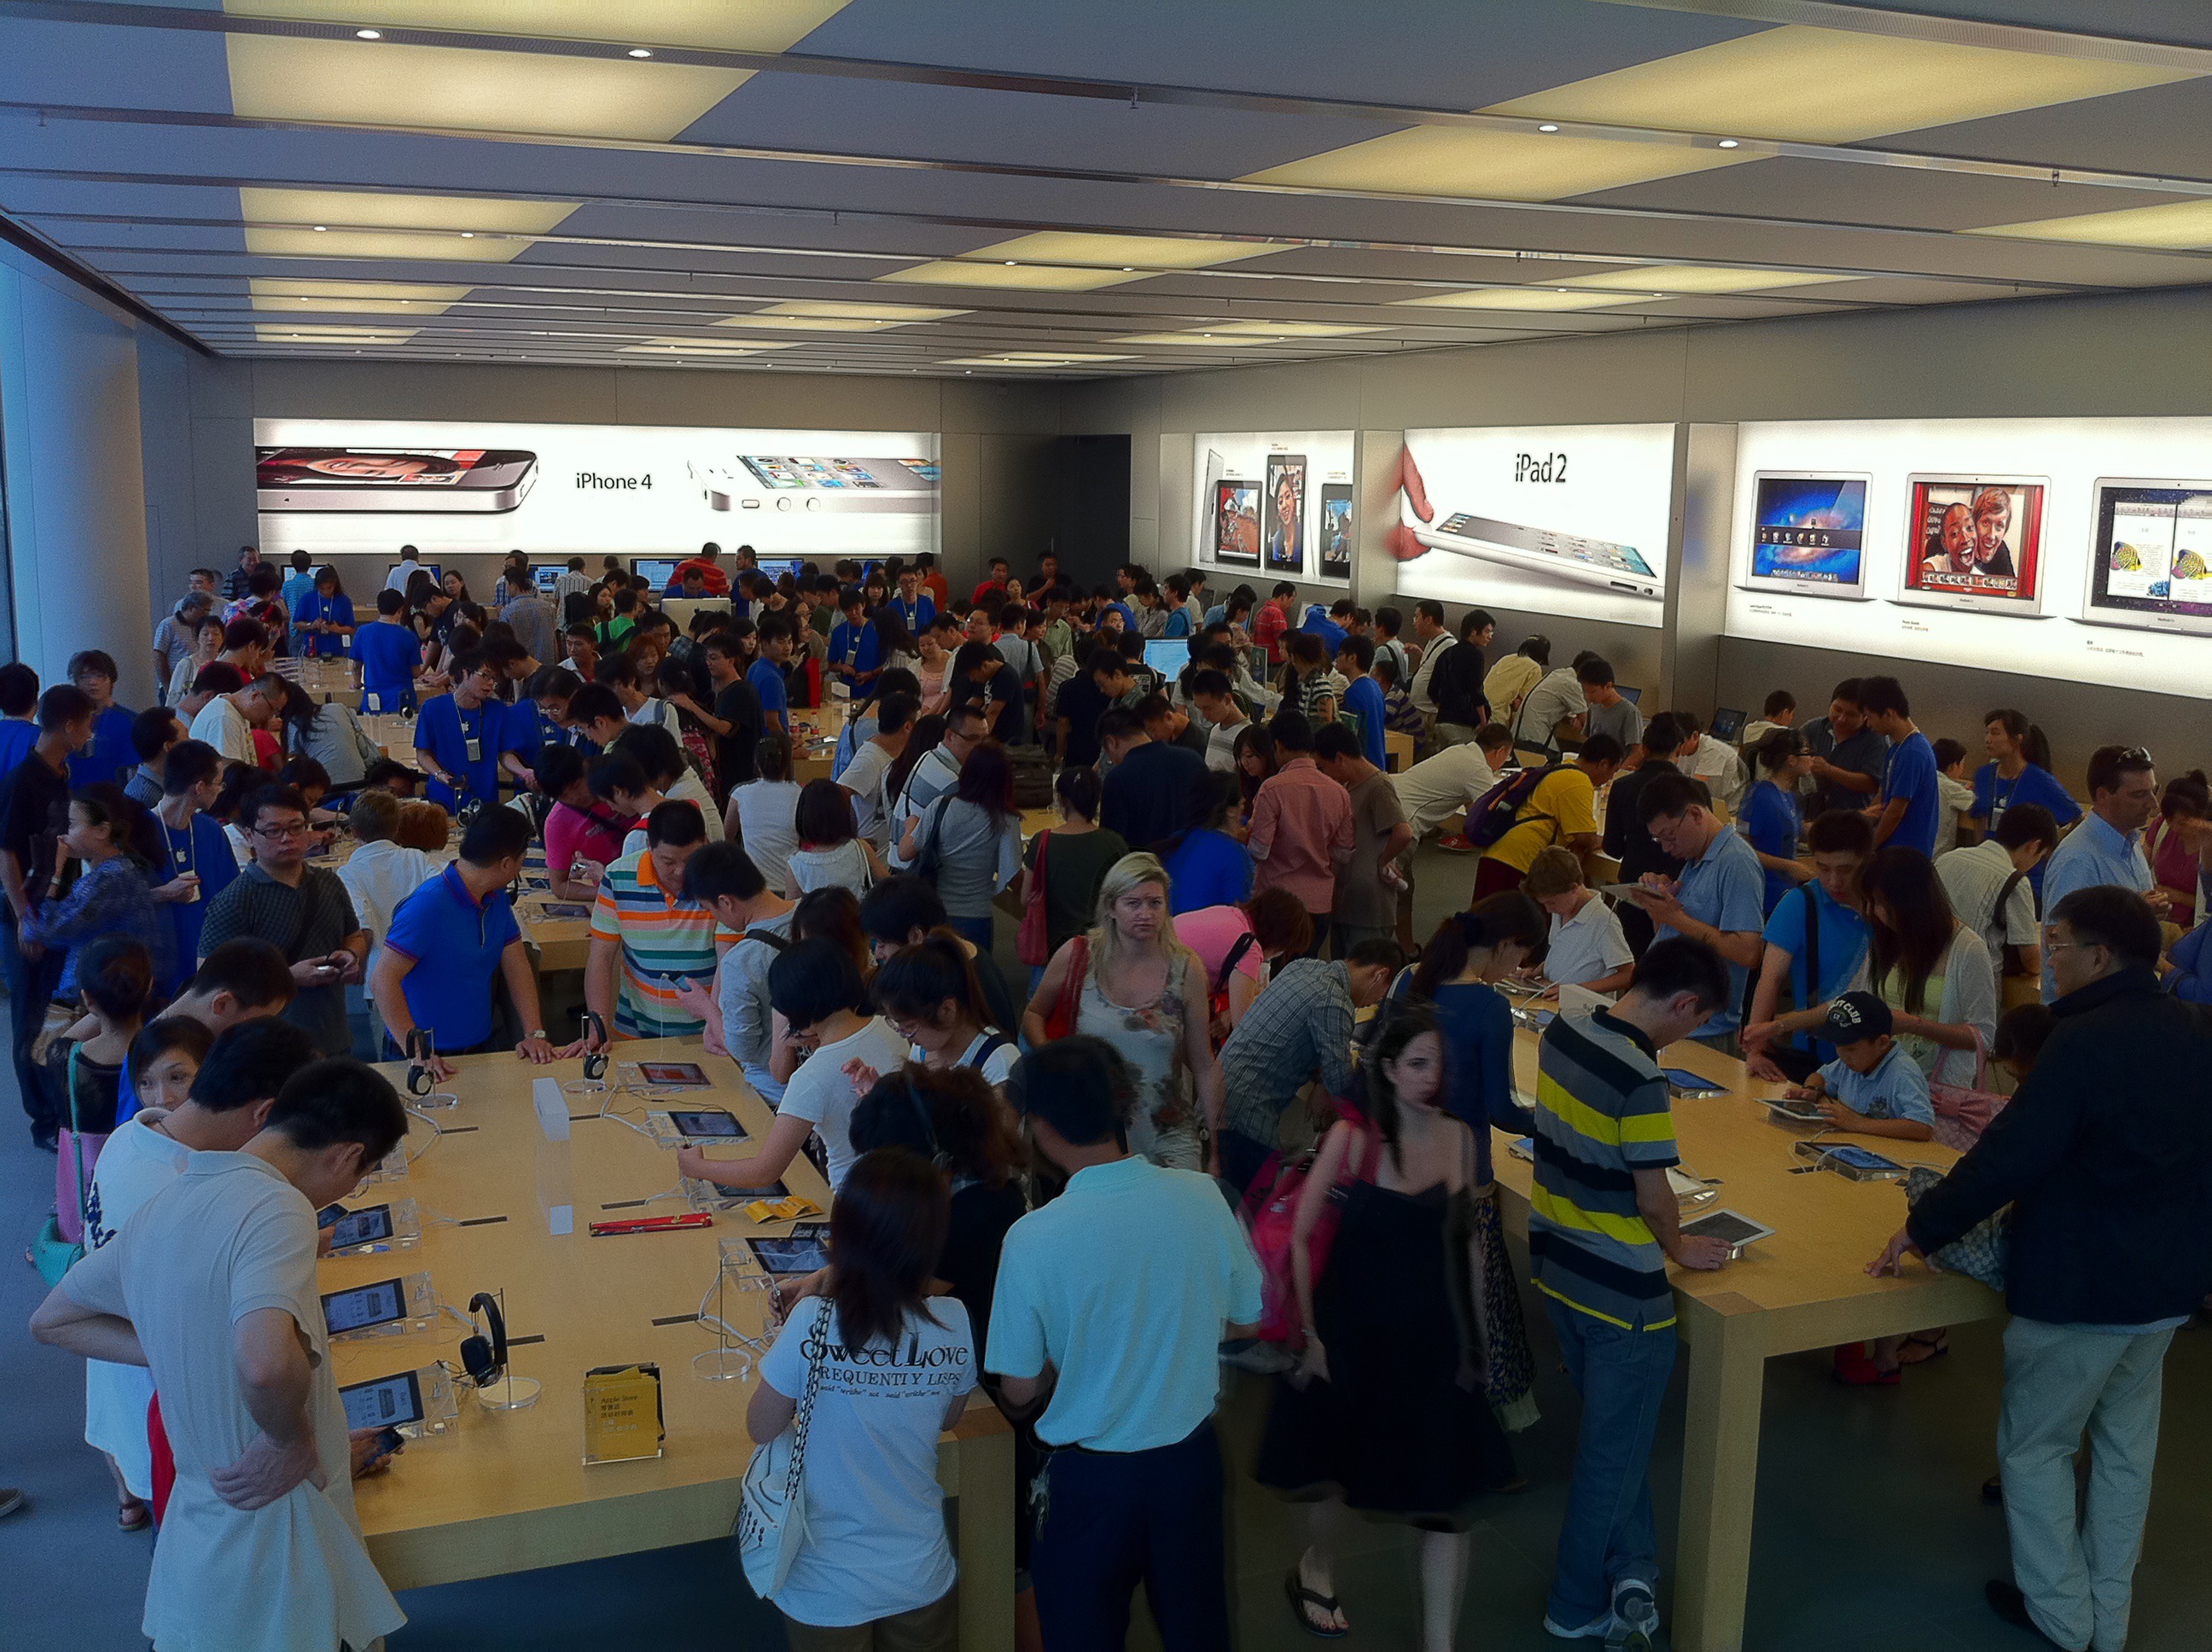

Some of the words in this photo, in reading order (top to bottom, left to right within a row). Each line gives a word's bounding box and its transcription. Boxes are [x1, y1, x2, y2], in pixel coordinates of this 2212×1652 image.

[576, 472, 637, 490] iPhone
[641, 474, 653, 490] 4
[1516, 452, 1552, 482] iPad
[1555, 453, 1567, 483] 2
[904, 1332, 969, 1369] Love
